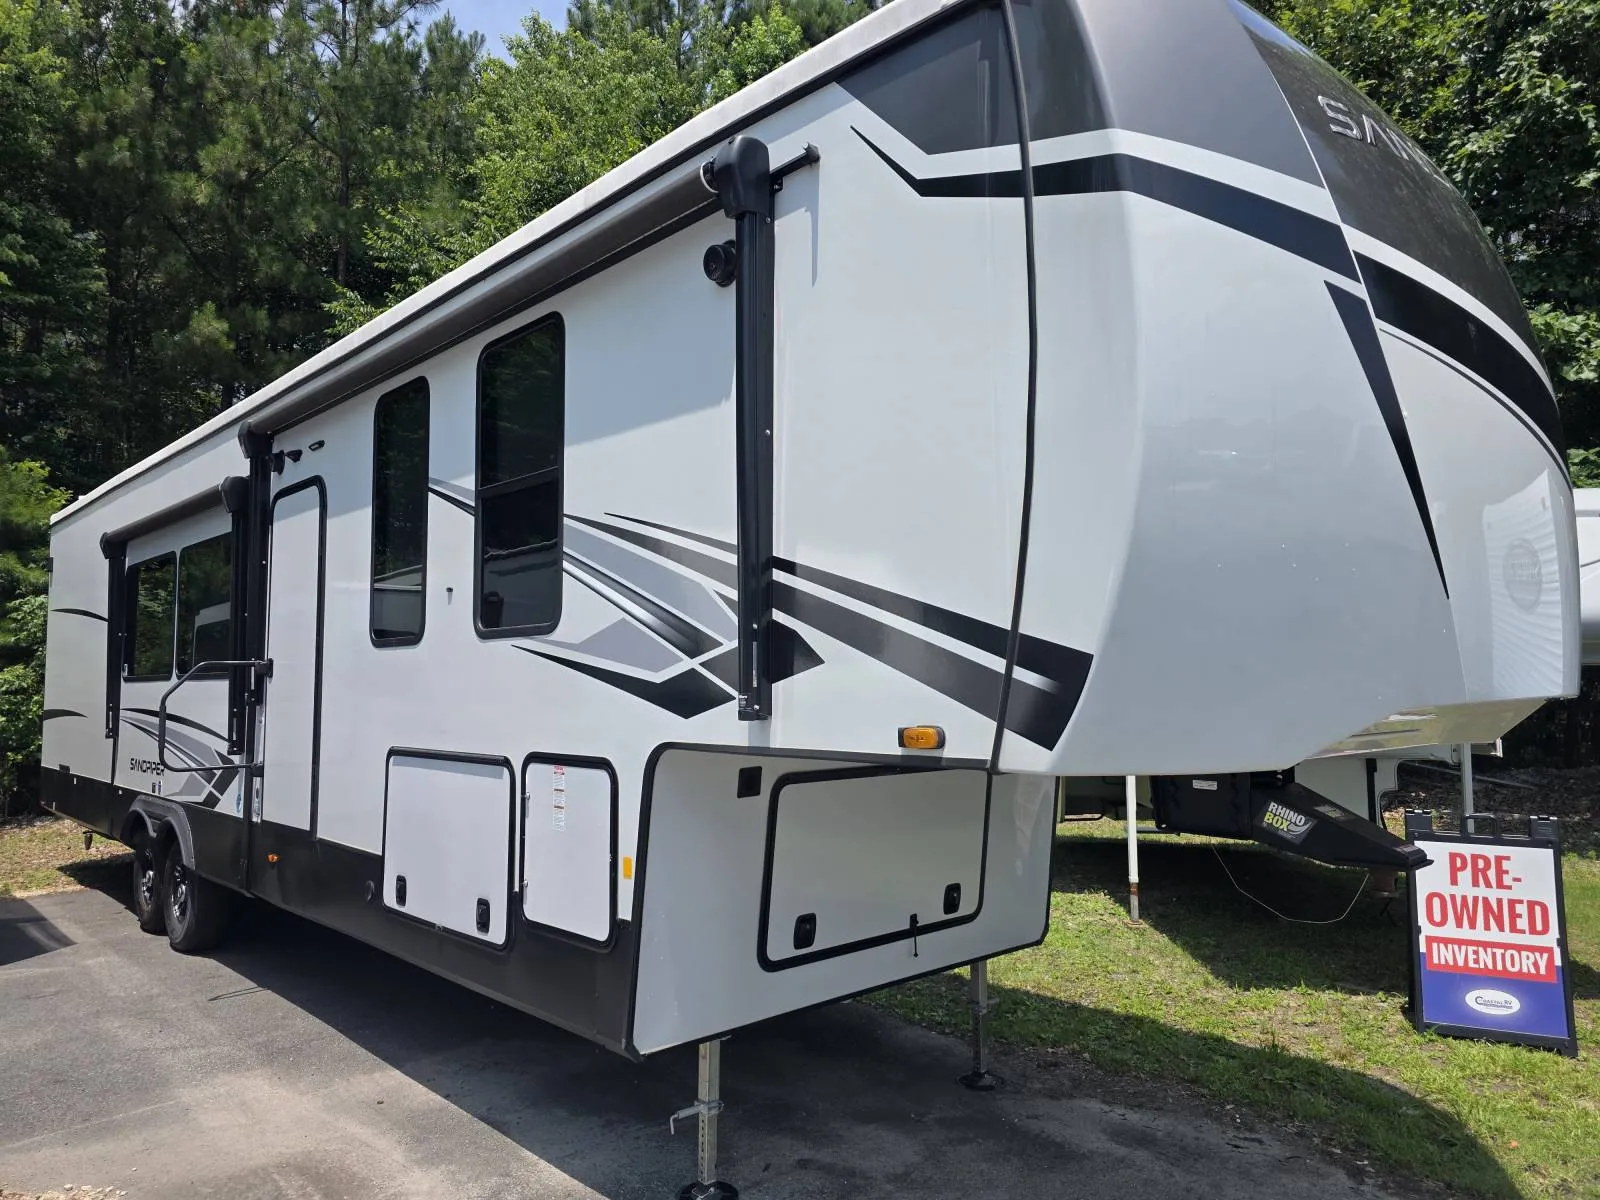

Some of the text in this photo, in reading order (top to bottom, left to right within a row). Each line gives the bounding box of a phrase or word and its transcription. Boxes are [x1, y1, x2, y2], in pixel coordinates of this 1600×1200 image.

[1263, 811, 1289, 832] BOX
[1268, 801, 1306, 826] RHINO
[1448, 851, 1522, 891] PRE-
[1425, 891, 1550, 936] OWNED
[1431, 942, 1549, 975] INVENTORY
